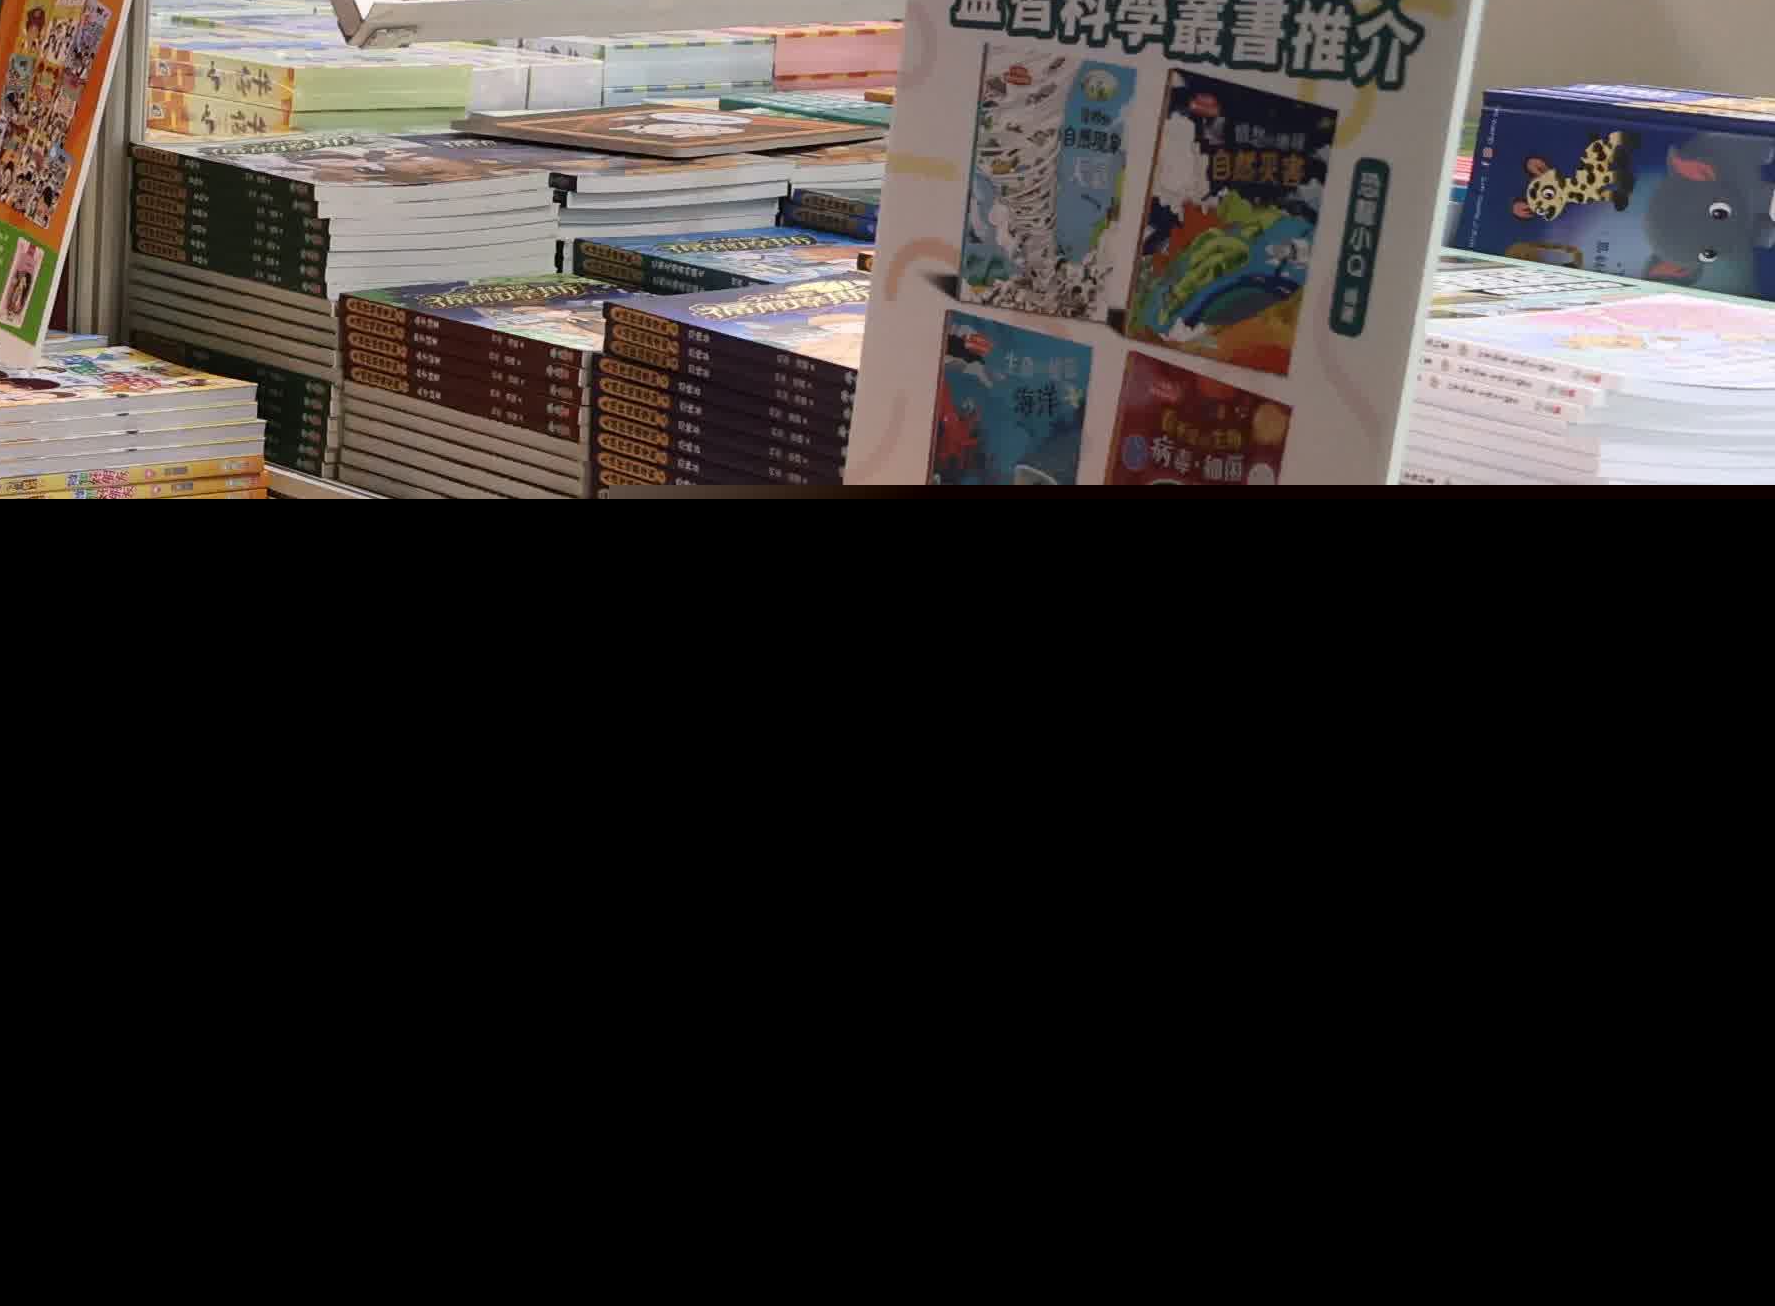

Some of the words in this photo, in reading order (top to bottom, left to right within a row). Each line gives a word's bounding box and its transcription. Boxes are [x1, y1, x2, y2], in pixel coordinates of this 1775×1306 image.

[1062, 124, 1122, 155] 自然現象
[1212, 151, 1306, 188] 自然災害
[1014, 383, 1058, 417] 海洋
